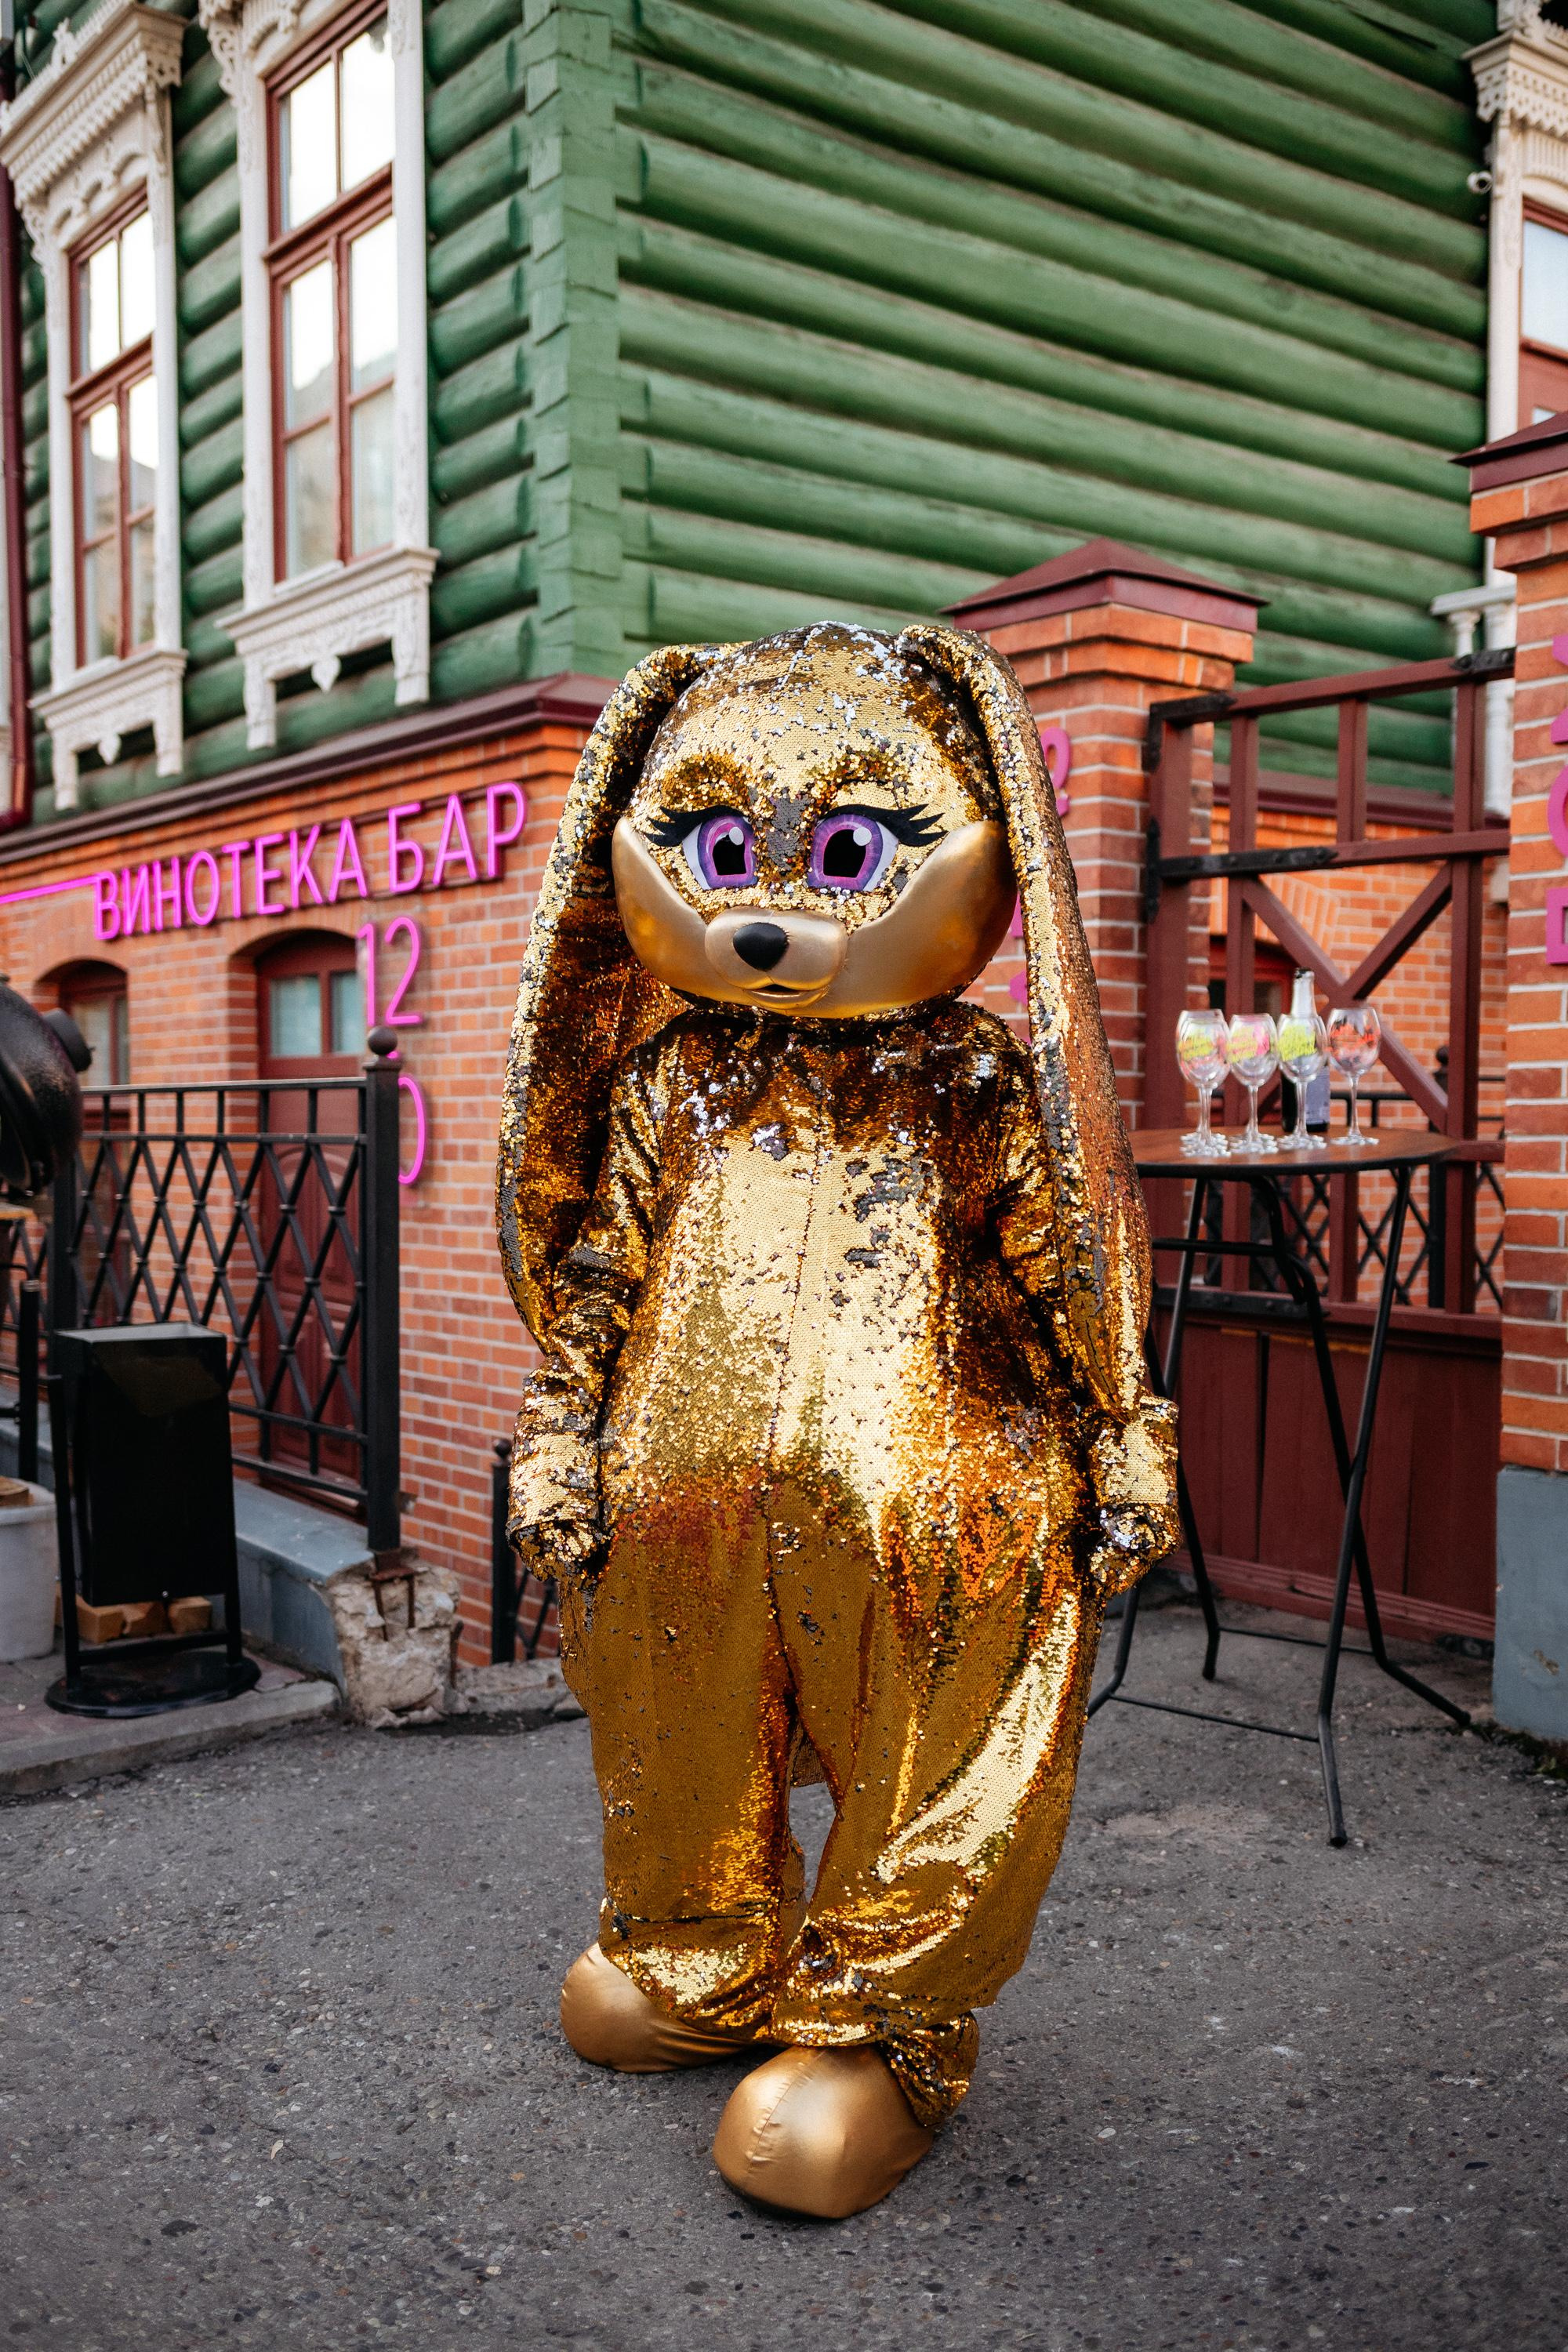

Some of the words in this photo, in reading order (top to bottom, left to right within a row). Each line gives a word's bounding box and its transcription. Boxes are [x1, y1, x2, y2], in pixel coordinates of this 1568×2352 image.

[93, 818, 368, 940] ВИНОТЕКА
[387, 782, 528, 894] БАР
[357, 916, 423, 1027] 12
